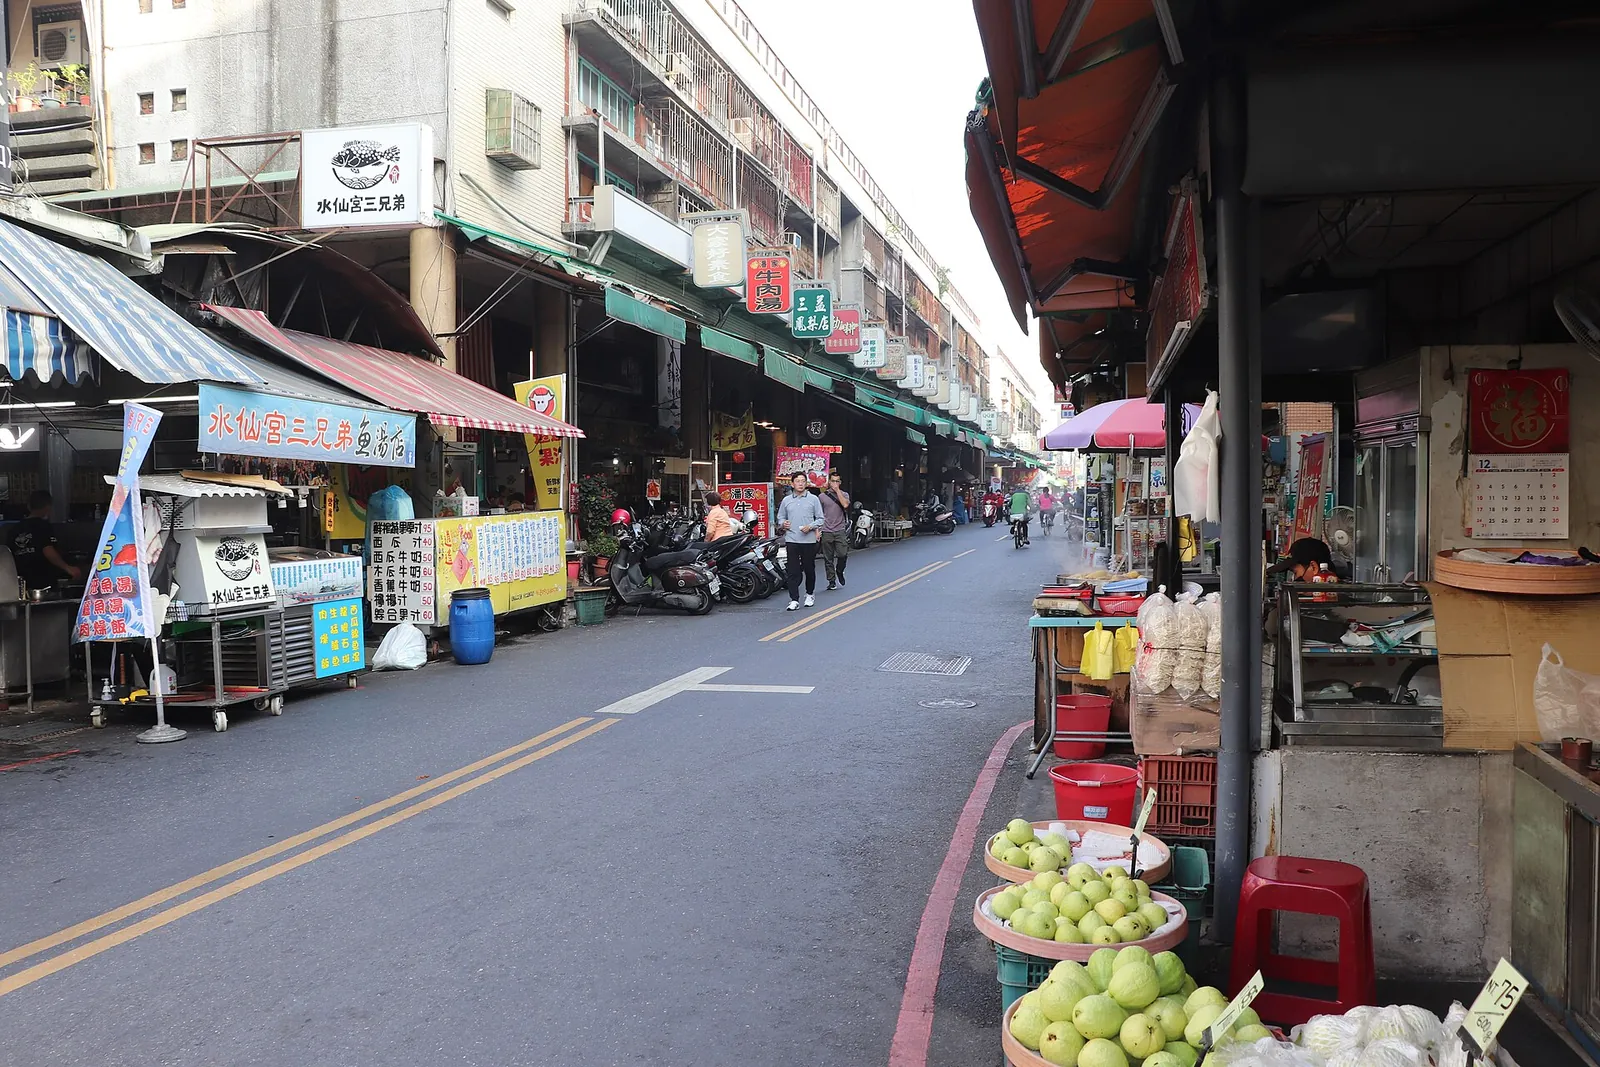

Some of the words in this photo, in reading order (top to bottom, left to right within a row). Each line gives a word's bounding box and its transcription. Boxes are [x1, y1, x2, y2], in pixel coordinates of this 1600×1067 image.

[317, 194, 405, 214] 水仙宮三兄弟
[755, 270, 782, 311] 牛肉湯
[797, 295, 826, 312] 三益
[795, 315, 829, 331] 鳳梨店
[1490, 382, 1546, 442] 福
[207, 404, 405, 461] 水仙宮三兄弟魚湯店
[1479, 460, 1490, 468] 12
[730, 488, 755, 500] 潘家
[423, 524, 432, 533] 95
[374, 537, 422, 548] 西瓜汁
[423, 538, 432, 546] 40
[374, 551, 422, 563] 西瓜牛奶
[423, 553, 432, 561] 50
[374, 565, 420, 578] 木瓜牛奶
[374, 579, 420, 592] 香蕉牛奶
[212, 584, 270, 604] 水仙宮三兄弟
[374, 594, 407, 607] 檸檬汁
[422, 597, 432, 605] 50
[375, 608, 420, 621] 綜合果汁
[423, 611, 432, 619] 60
[1494, 979, 1519, 1010] 75
